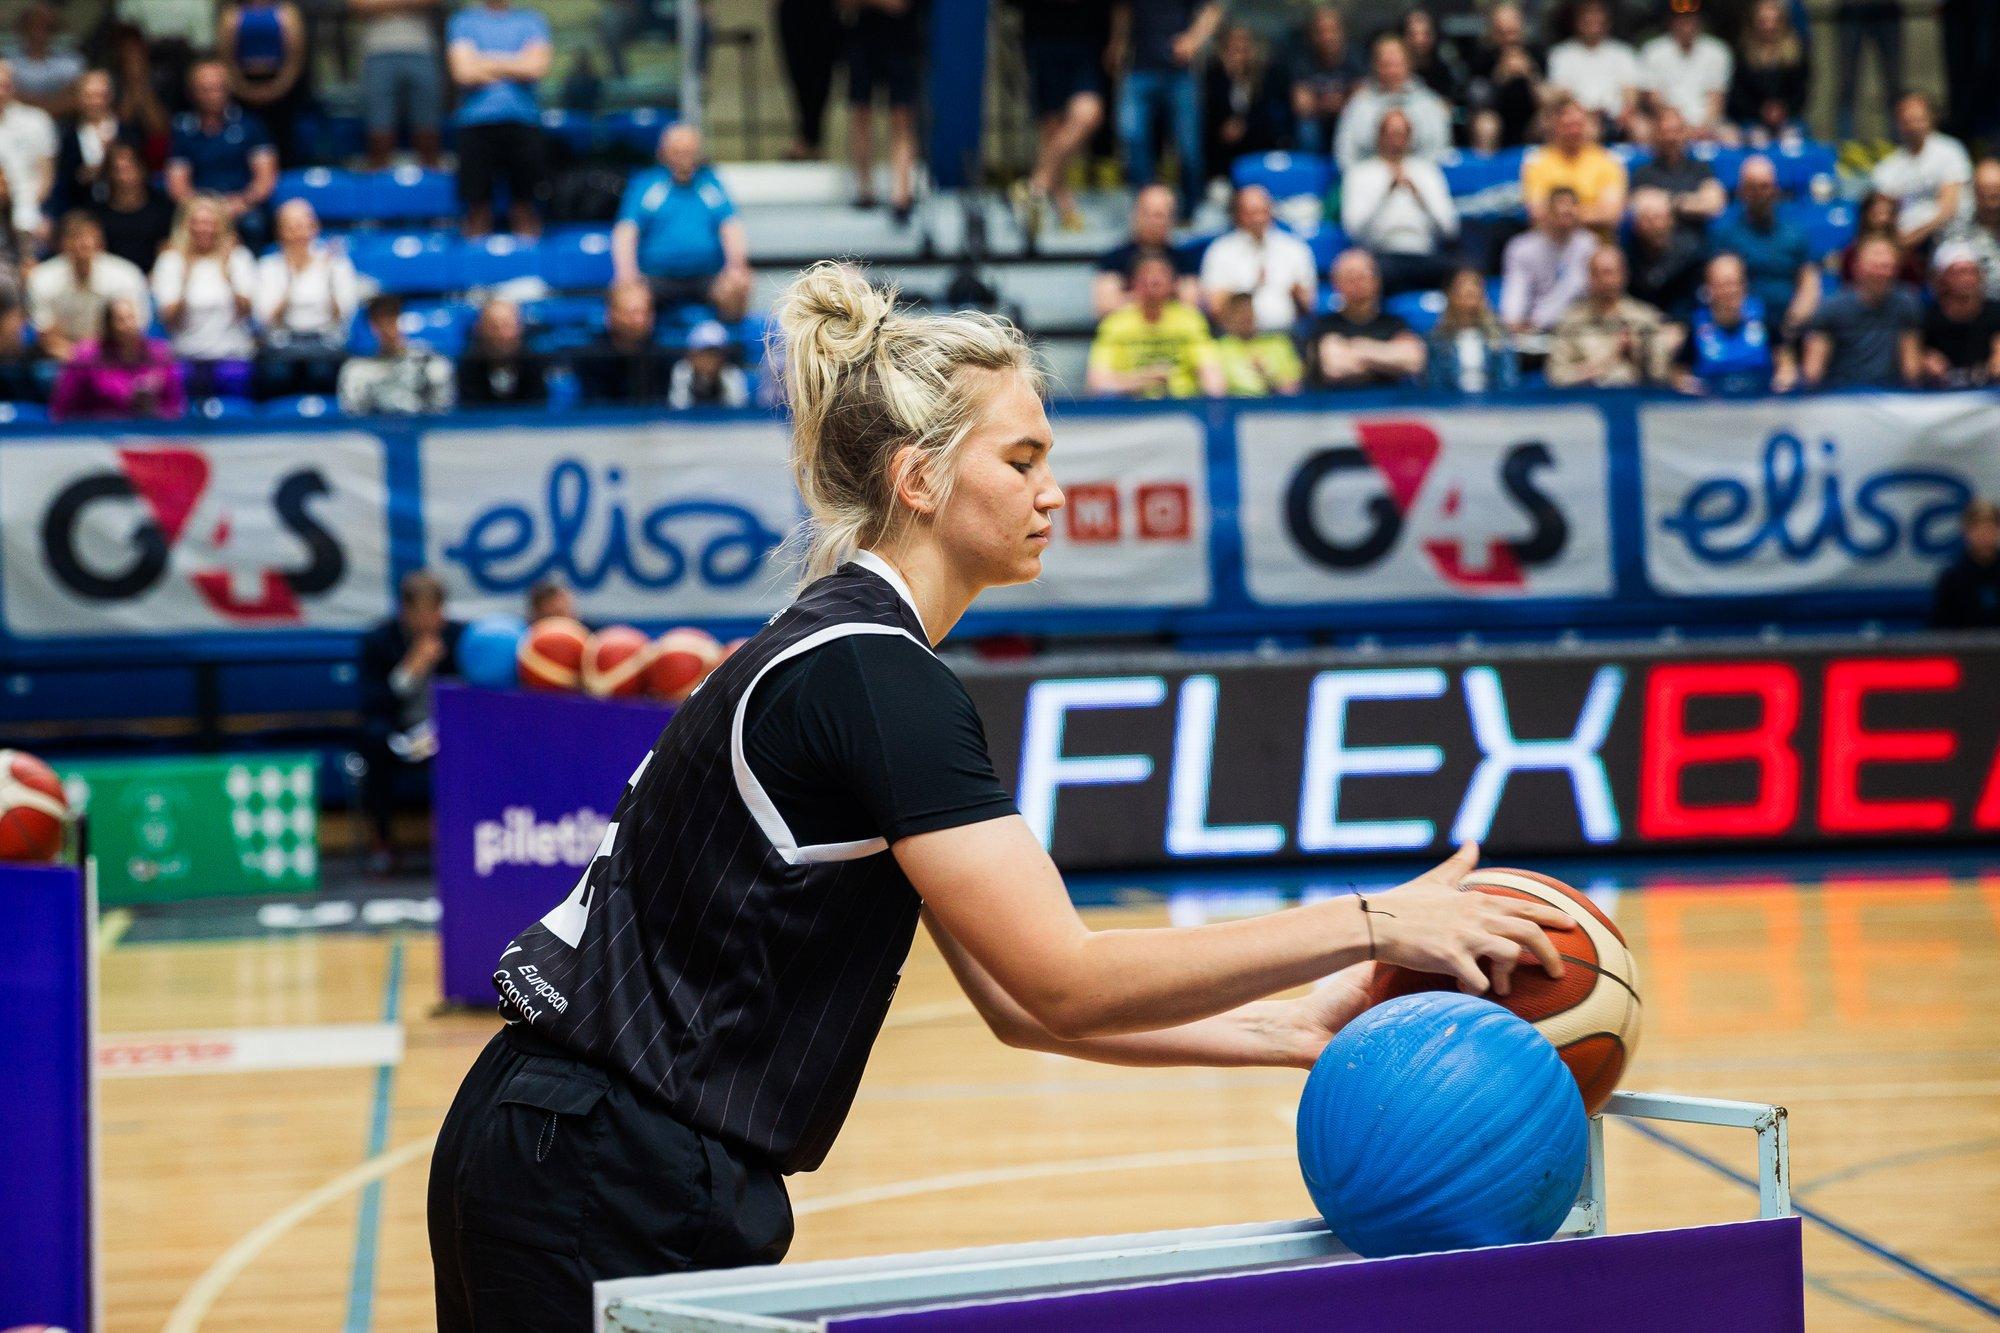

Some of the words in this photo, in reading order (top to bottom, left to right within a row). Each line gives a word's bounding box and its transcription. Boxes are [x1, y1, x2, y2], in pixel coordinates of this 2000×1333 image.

[41, 447, 349, 623] G4S
[445, 458, 783, 592] elisa
[1283, 418, 1571, 590] G4S
[1662, 431, 1971, 563] elisa
[517, 964, 569, 1015] European
